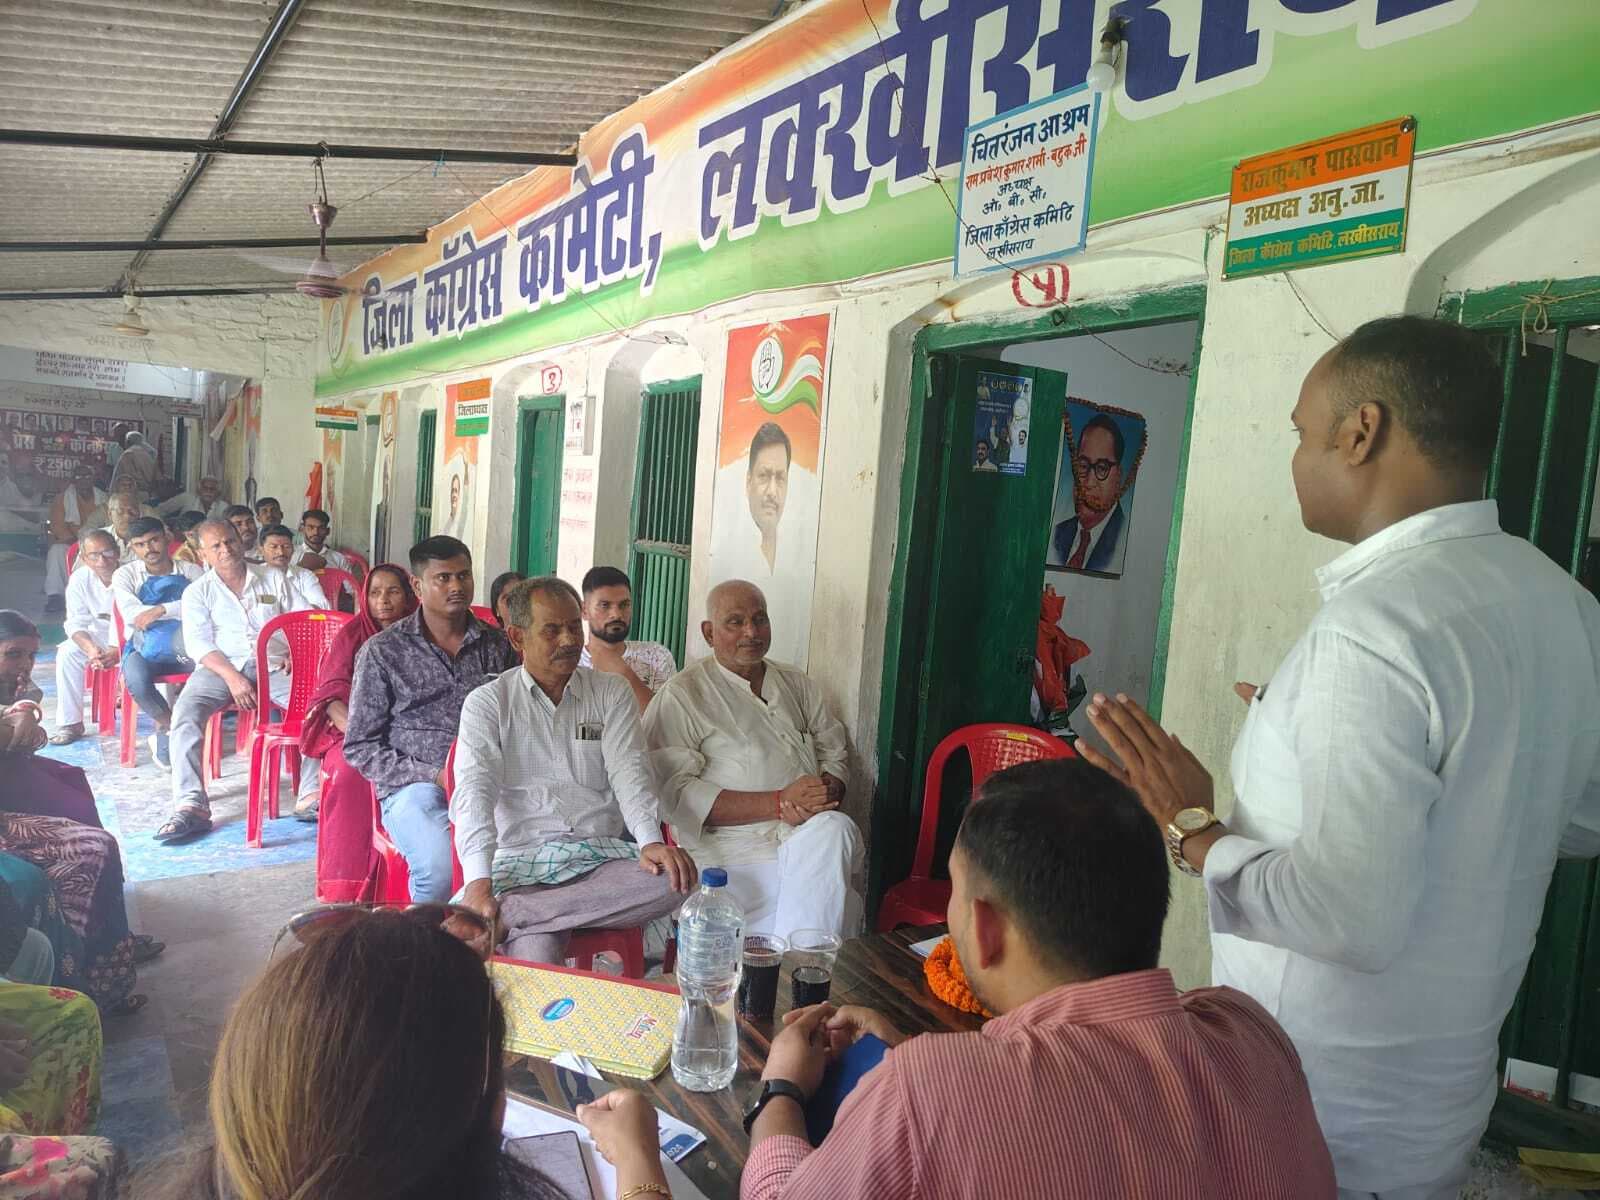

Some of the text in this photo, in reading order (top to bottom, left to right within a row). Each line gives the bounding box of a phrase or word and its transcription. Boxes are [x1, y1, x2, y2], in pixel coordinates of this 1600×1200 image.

[971, 104, 1090, 164] चितरंजन आश्रम
[1003, 159, 1026, 181] कुमार
[1241, 134, 1401, 193] राजकुमार पासवान
[1244, 197, 1301, 227] अध्यक्ष
[965, 224, 994, 248] जिला
